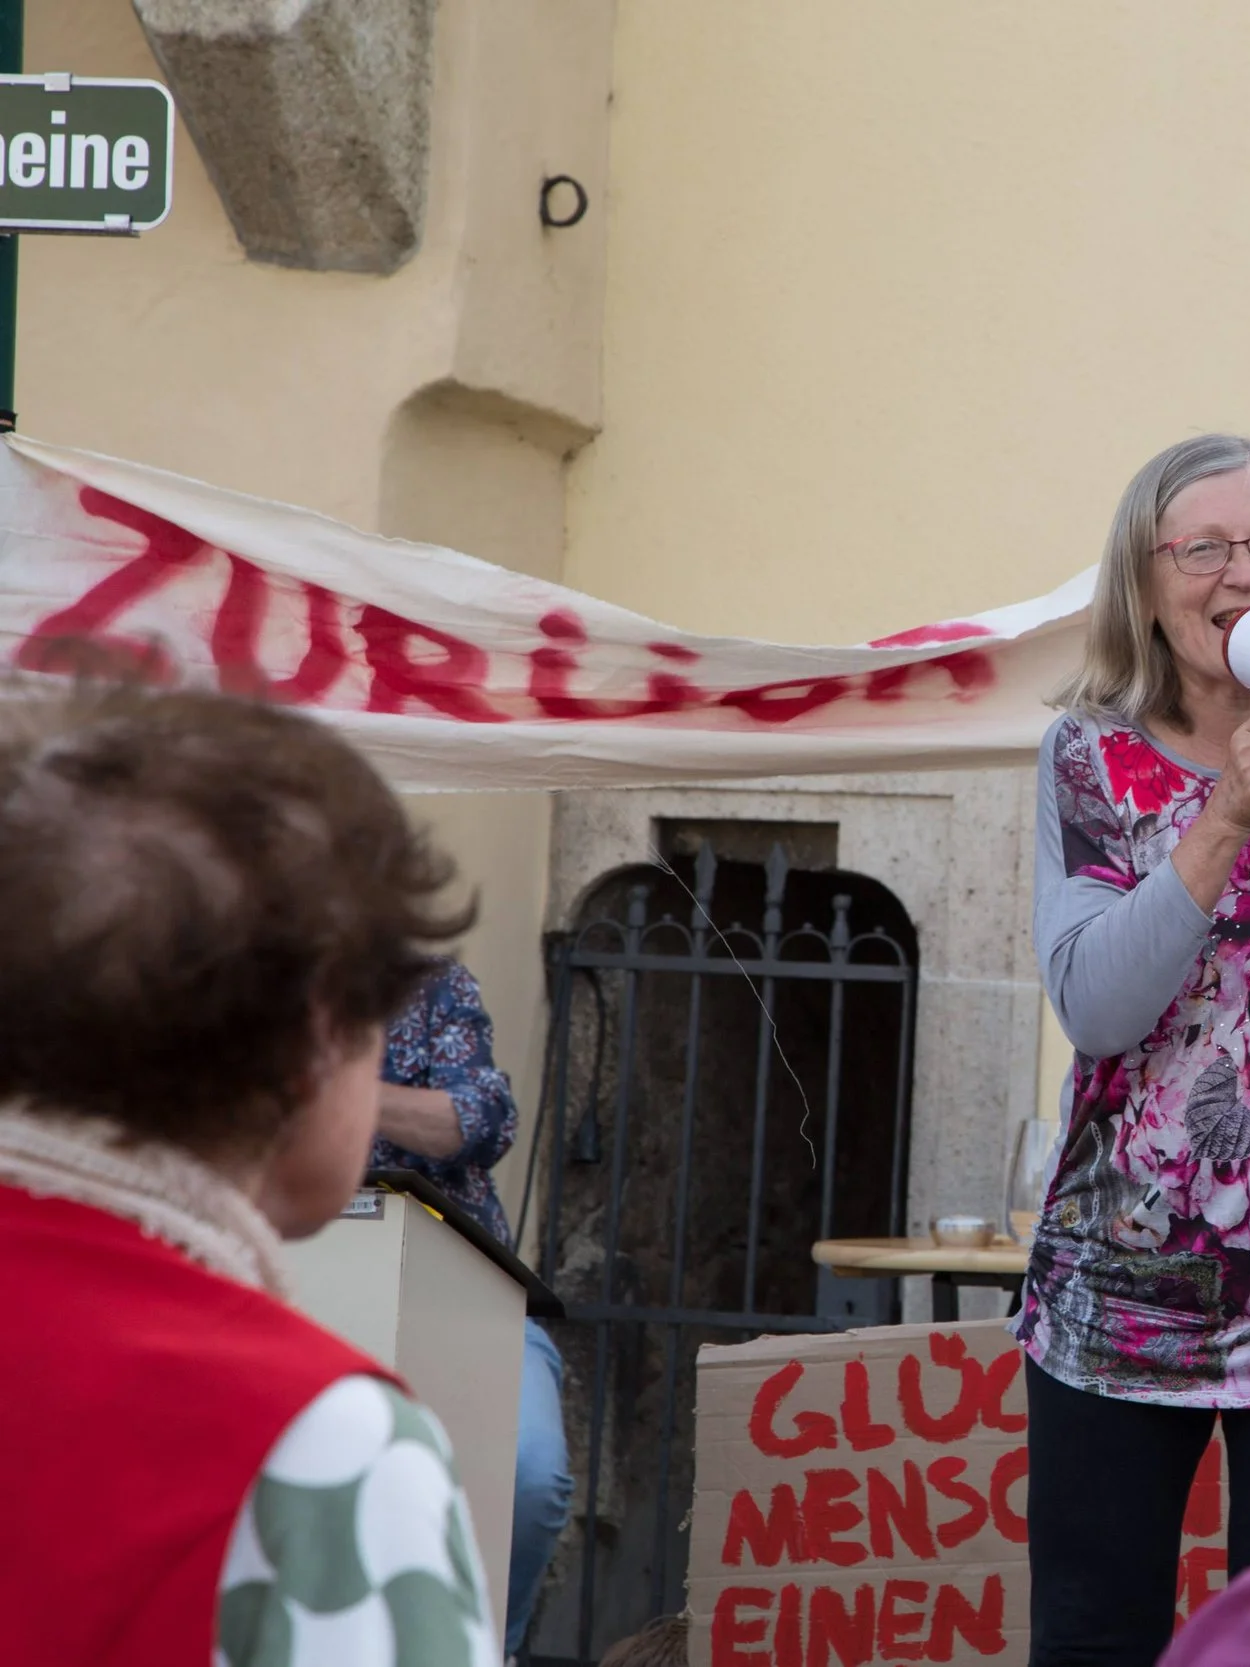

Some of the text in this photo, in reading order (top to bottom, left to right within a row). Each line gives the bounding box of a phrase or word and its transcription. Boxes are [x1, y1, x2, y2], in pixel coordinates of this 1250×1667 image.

[0, 110, 150, 191] eine
[748, 1332, 1029, 1459] GLÜC
[720, 1445, 1029, 1568] MENSC
[710, 1573, 1008, 1667] EINEN
